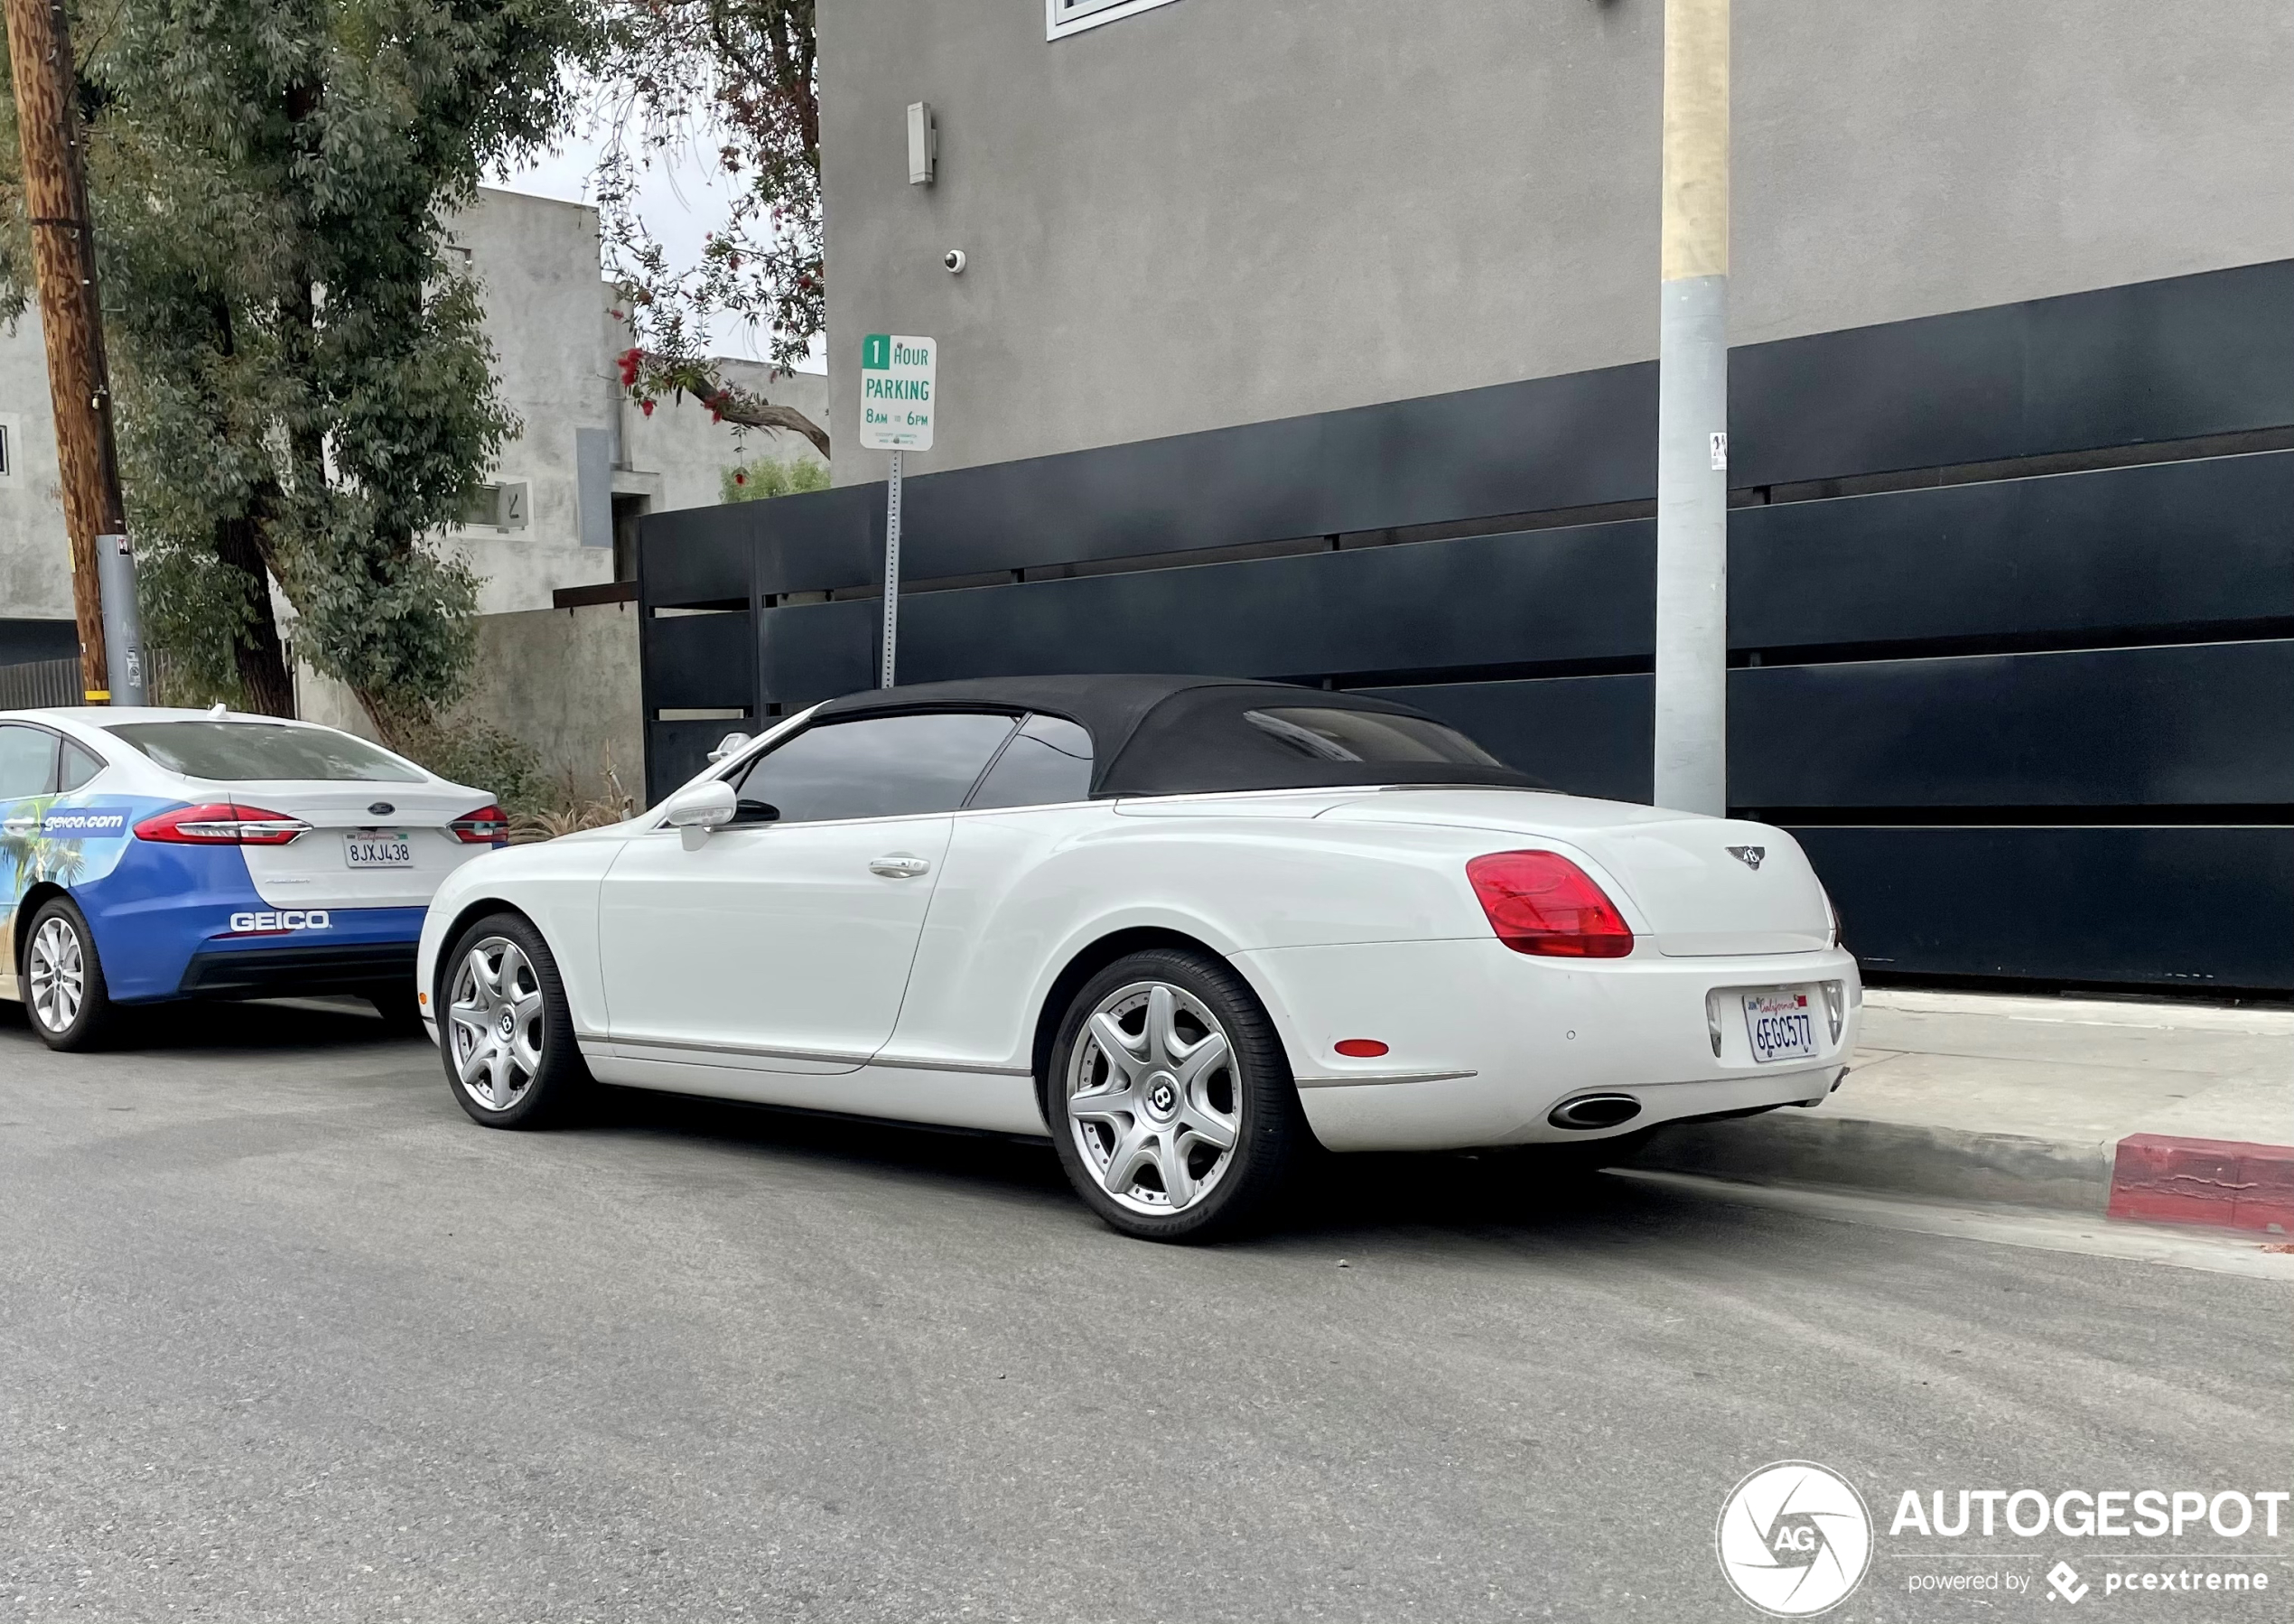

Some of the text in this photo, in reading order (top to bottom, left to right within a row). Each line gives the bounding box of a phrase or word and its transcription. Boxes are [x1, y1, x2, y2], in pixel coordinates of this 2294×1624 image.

[872, 340, 928, 366] 1 HOUR
[866, 378, 929, 401] PARKING
[865, 407, 888, 425] 8AM
[907, 410, 928, 425] 6PM
[43, 815, 124, 832] geico.com
[350, 844, 410, 862] 8JXJ438
[229, 910, 331, 931] GEICO
[1758, 997, 1800, 1017] California
[1757, 1014, 1812, 1050] 6EGC577
